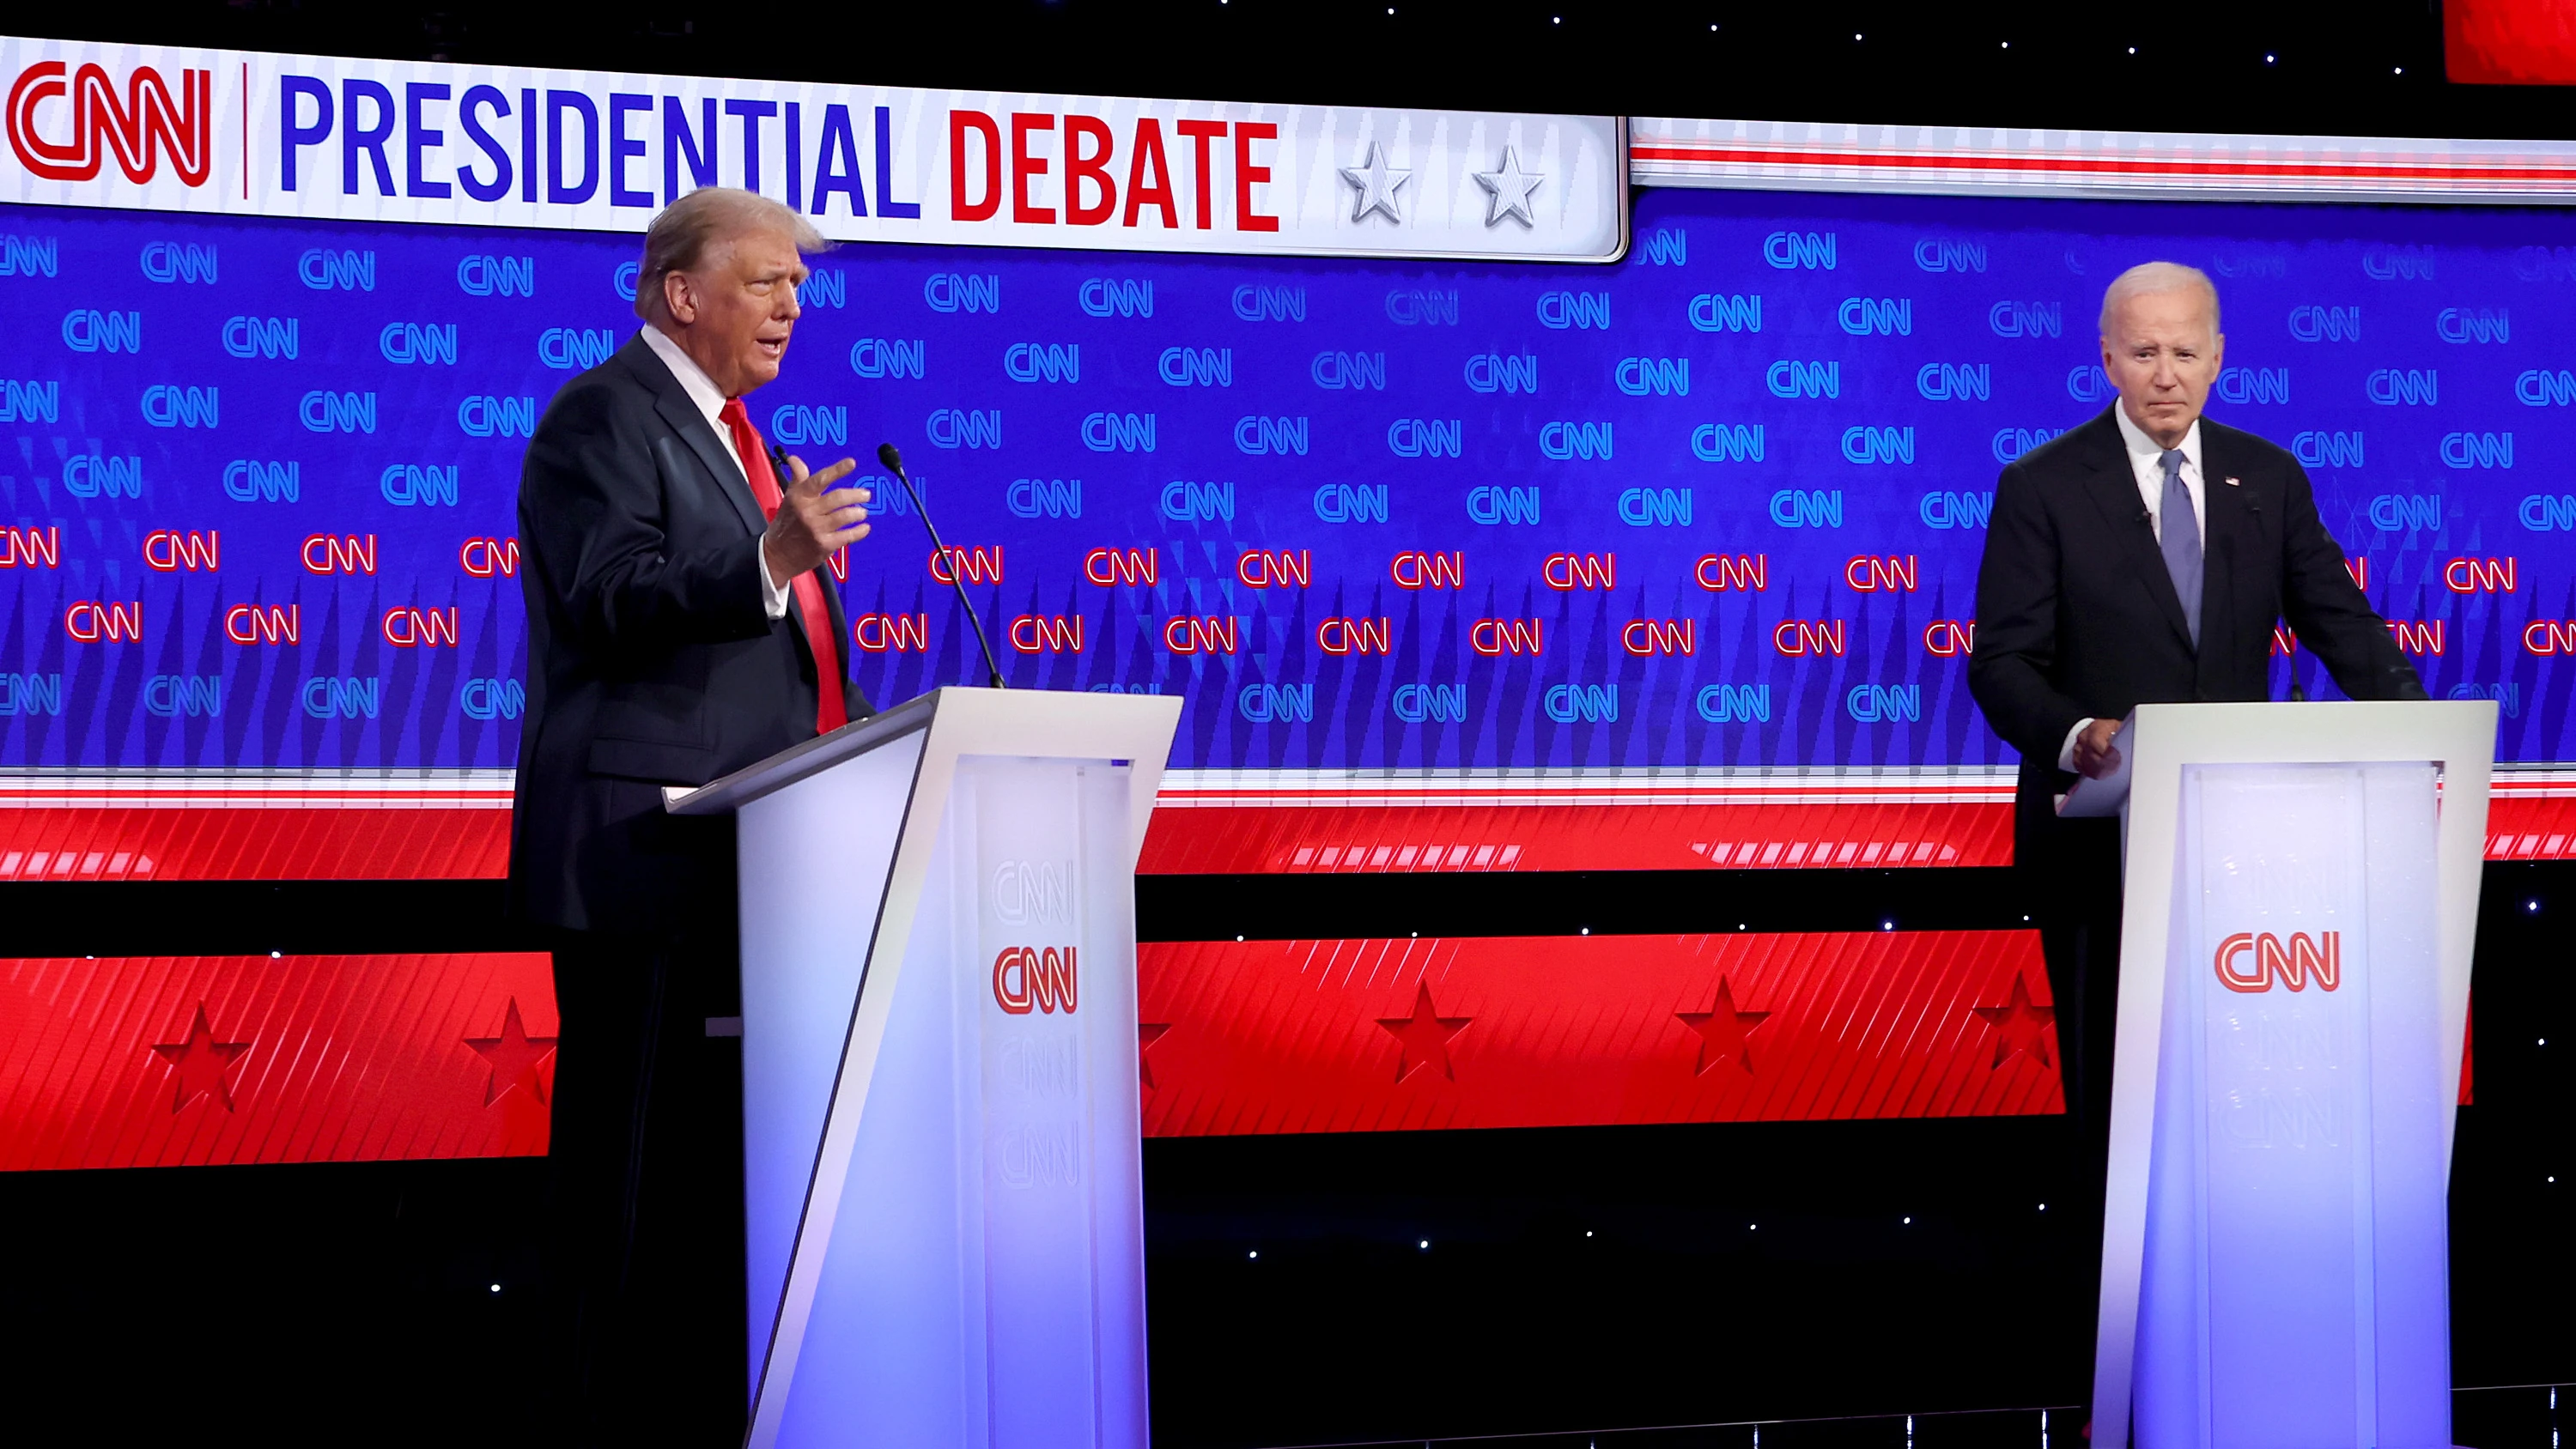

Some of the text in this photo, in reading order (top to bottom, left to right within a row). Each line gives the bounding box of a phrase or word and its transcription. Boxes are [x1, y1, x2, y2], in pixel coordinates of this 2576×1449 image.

[6, 61, 210, 187] CNN
[281, 75, 1279, 233] PRESIDENTIAL DEBATE
[141, 243, 217, 284] CNN
[299, 250, 374, 291] CNN
[1764, 232, 1836, 270] CNN
[1914, 237, 1987, 273] CNN
[458, 255, 533, 297] CNN
[925, 274, 999, 313] CNN
[1079, 278, 1153, 318] CNN
[1231, 284, 1306, 322] CNN
[1385, 288, 1459, 326] CNN
[1537, 292, 1610, 330] CNN
[1688, 294, 1761, 332] CNN
[1838, 298, 1911, 336] CNN
[62, 310, 140, 354] CNN
[222, 316, 298, 360] CNN
[1990, 300, 2061, 338] CNN
[2289, 306, 2360, 343] CNN
[2437, 307, 2509, 344] CNN
[380, 323, 457, 365] CNN
[851, 339, 924, 379] CNN
[1005, 343, 1078, 383] CNN
[1158, 348, 1231, 386] CNN
[1312, 352, 1385, 390] CNN
[1465, 355, 1536, 393] CNN
[1615, 357, 1689, 396] CNN
[1766, 361, 1839, 399] CNN
[1917, 363, 1990, 401] CNN
[2216, 368, 2288, 404] CNN
[141, 385, 218, 428] CNN
[2367, 369, 2437, 405] CNN
[300, 391, 376, 433] CNN
[459, 396, 534, 438] CNN
[771, 404, 847, 446] CNN
[927, 409, 1000, 449] CNN
[1081, 413, 1155, 452] CNN
[1235, 416, 1308, 455] CNN
[1388, 419, 1461, 458] CNN
[1540, 421, 1613, 460] CNN
[1691, 424, 1764, 462] CNN
[1842, 427, 1914, 464] CNN
[2292, 432, 2363, 468] CNN
[2440, 433, 2512, 469] CNN
[64, 453, 141, 499] CNN
[223, 460, 299, 502] CNN
[380, 464, 458, 506] CNN
[853, 476, 926, 515] CNN
[1007, 479, 1081, 518] CNN
[1161, 482, 1235, 521] CNN
[1314, 484, 1388, 523] CNN
[1467, 486, 1540, 524] CNN
[1618, 488, 1692, 526] CNN
[1770, 489, 1842, 528] CNN
[1920, 491, 1992, 529] CNN
[2369, 495, 2440, 532] CNN
[143, 530, 219, 572] CNN
[301, 534, 377, 575] CNN
[928, 546, 1003, 585] CNN
[1084, 548, 1158, 586] CNN
[1236, 549, 1311, 588] CNN
[1391, 551, 1464, 590] CNN
[1542, 553, 1615, 591] CNN
[1695, 554, 1767, 591] CNN
[1845, 555, 1917, 592] CNN
[2444, 558, 2517, 593] CNN
[64, 601, 142, 643] CNN
[224, 603, 300, 646] CNN
[382, 606, 459, 647] CNN
[854, 613, 928, 652] CNN
[1009, 615, 1084, 653] CNN
[1163, 616, 1237, 654] CNN
[1316, 617, 1391, 655] CNN
[1470, 618, 1542, 656] CNN
[1621, 619, 1695, 657] CNN
[1773, 620, 1845, 657] CNN
[2385, 620, 2445, 656] NN
[144, 676, 221, 717] CNN
[302, 677, 379, 718] CNN
[1239, 684, 1313, 722] CNN
[1393, 684, 1466, 723] CNN
[1545, 684, 1618, 723] CNN
[1697, 684, 1770, 723] CNN
[1847, 684, 1920, 722] CNN
[993, 860, 1073, 926] CNN
[993, 947, 1077, 1015] CNN
[2215, 931, 2340, 993] CNN
[1000, 1120, 1078, 1190] CNN
